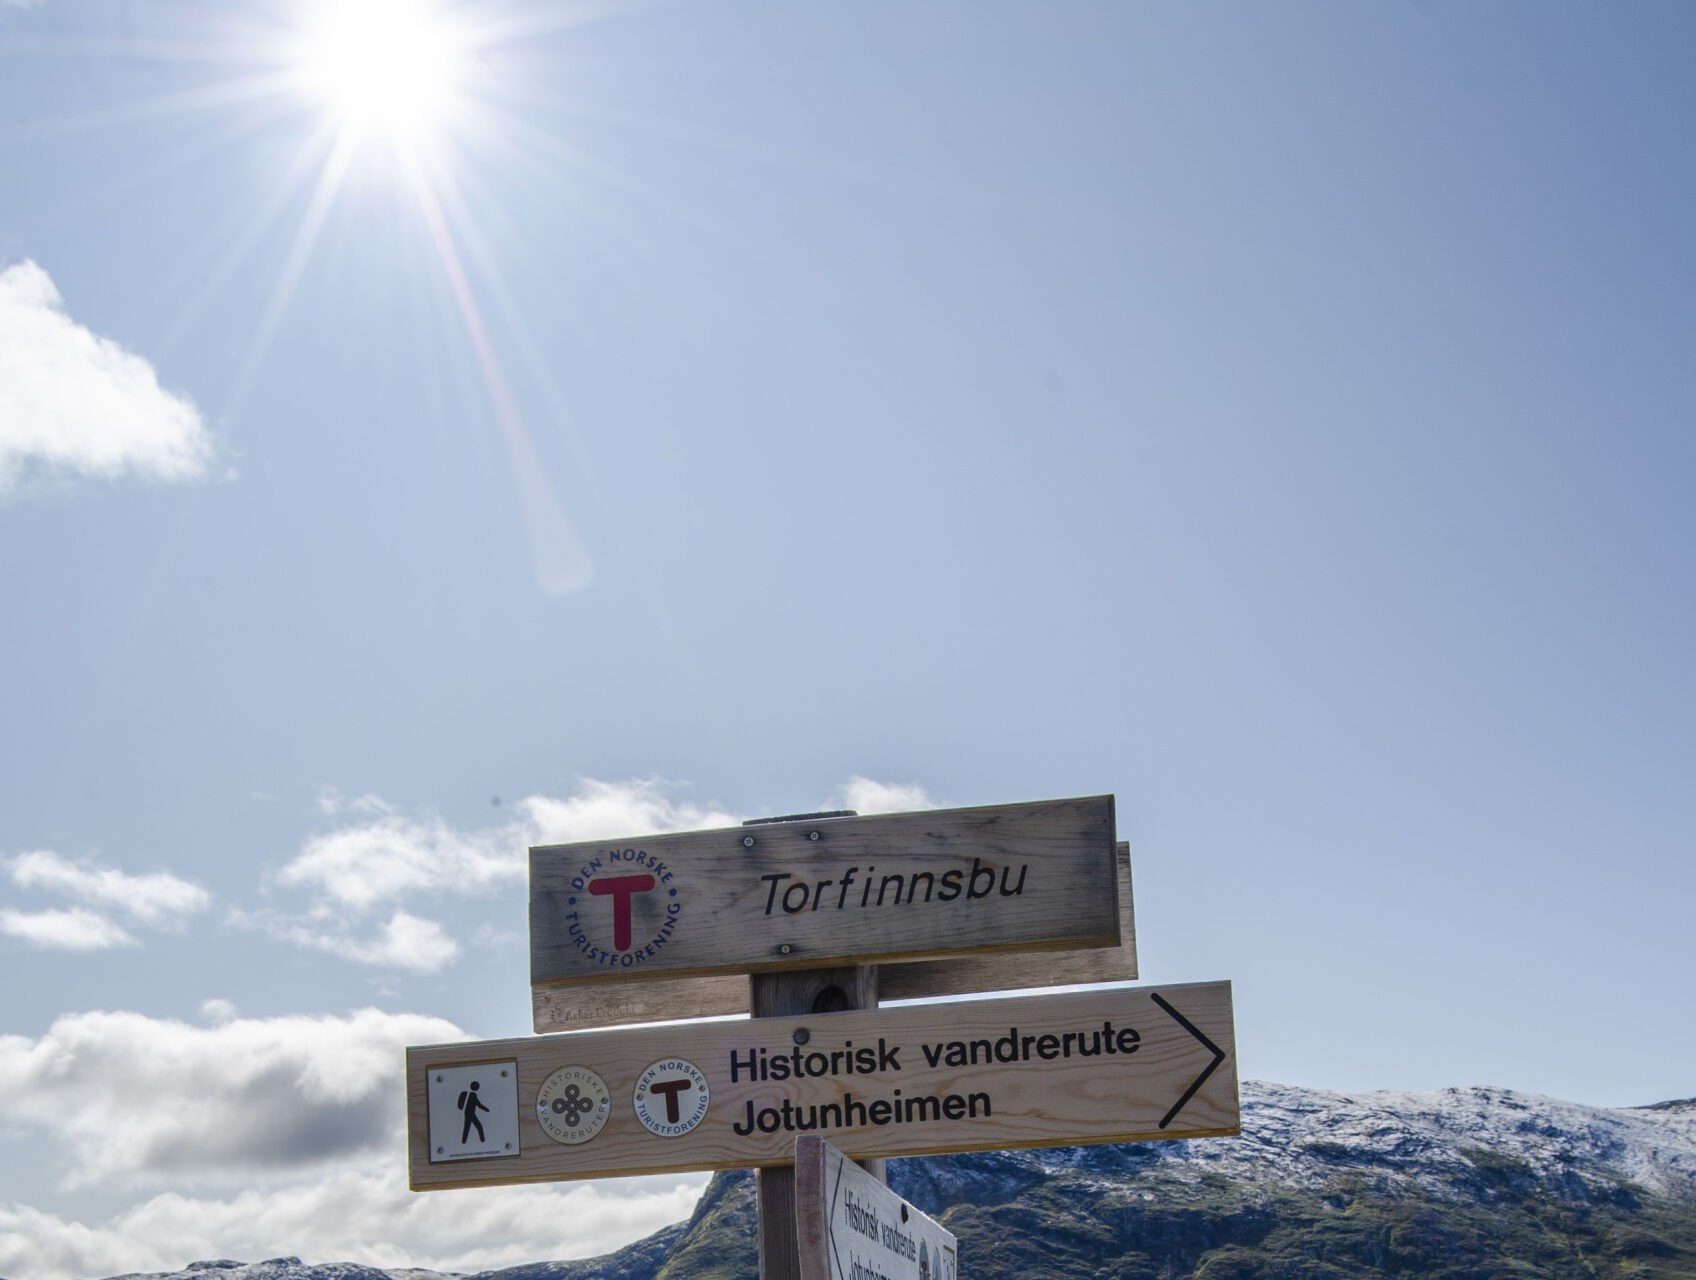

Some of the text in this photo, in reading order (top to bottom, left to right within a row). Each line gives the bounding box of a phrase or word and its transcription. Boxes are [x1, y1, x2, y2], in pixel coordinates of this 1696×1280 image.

[571, 848, 674, 890] DEN NORSKE
[761, 857, 1027, 915] Torfinnsbu
[566, 903, 680, 967] TURISTFORENING
[730, 1021, 1141, 1083] Historisk vandrerute
[543, 1071, 603, 1098] HISTORISKE
[638, 1061, 702, 1092] DEN NORSKE
[540, 1105, 606, 1139] VANDRERUTER
[637, 1095, 708, 1134] TURISTFORENING
[733, 1089, 991, 1136] Jotunheimen
[844, 1188, 916, 1263] Historisk vandrerute
